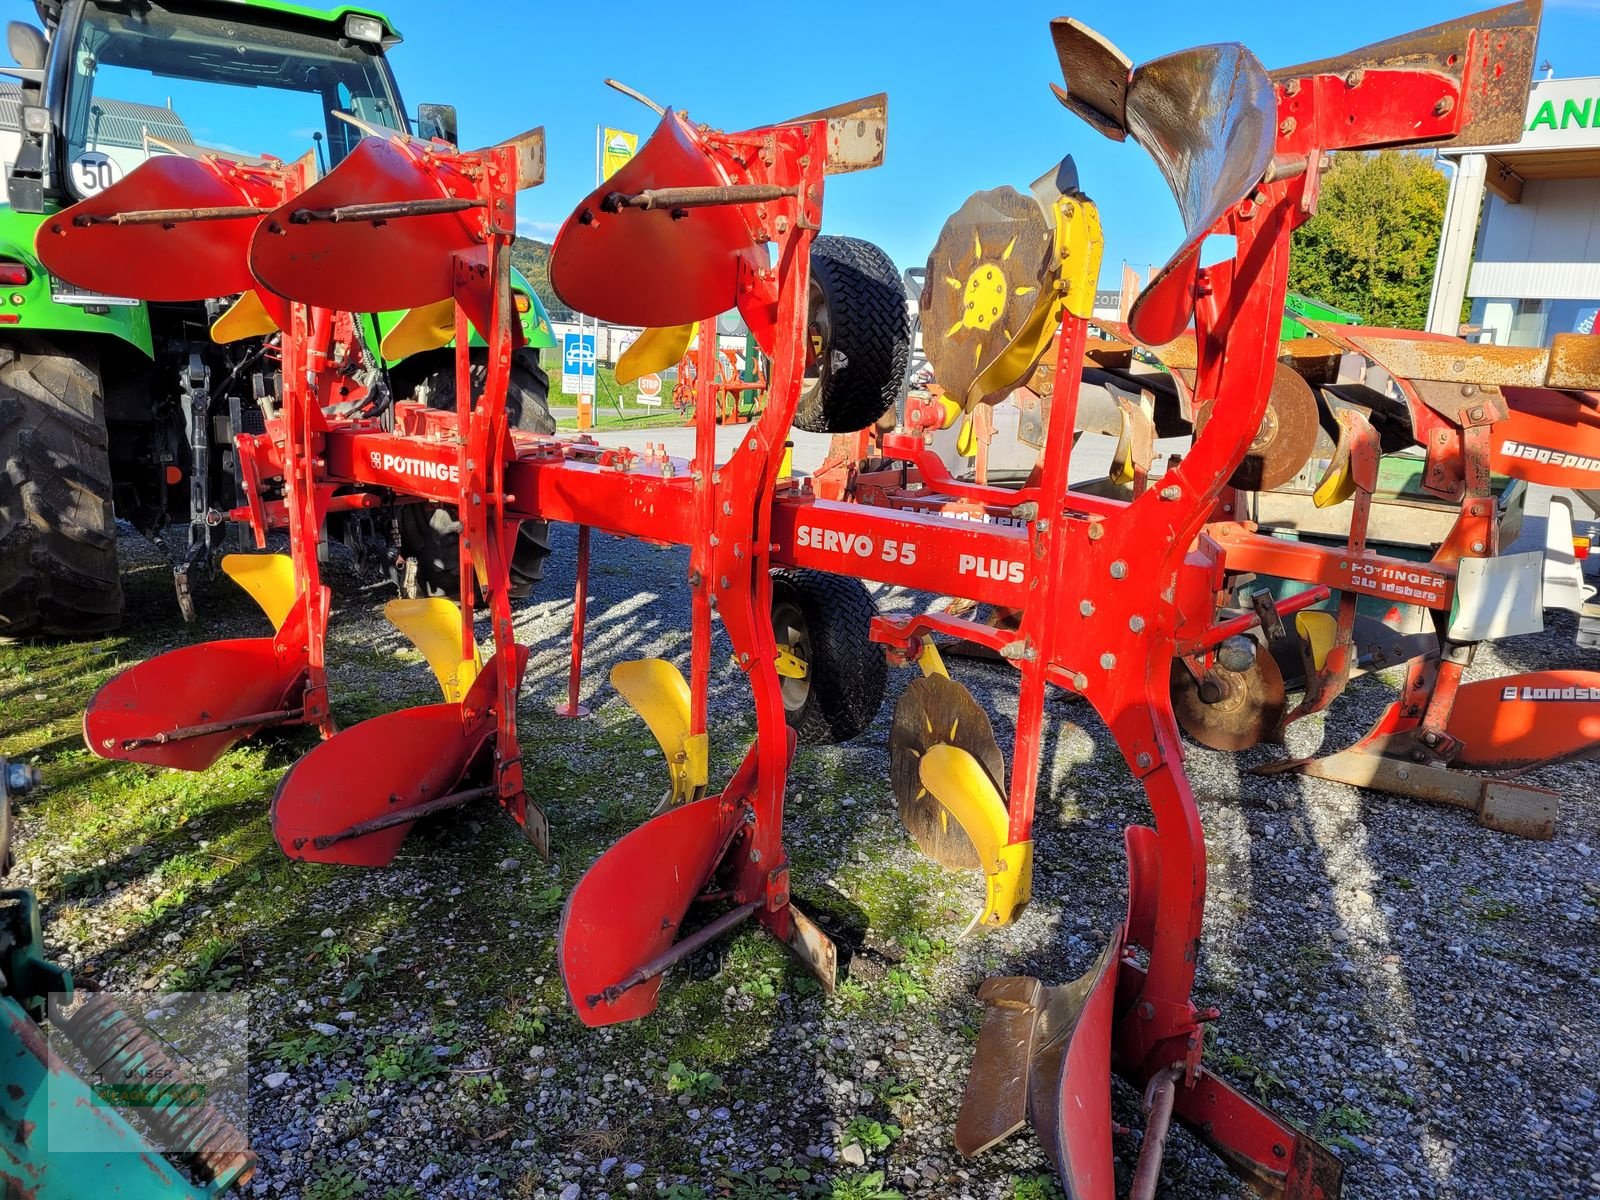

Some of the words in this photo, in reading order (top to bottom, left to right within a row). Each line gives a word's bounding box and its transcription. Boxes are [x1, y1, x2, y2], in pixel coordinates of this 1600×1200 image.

[1523, 97, 1600, 131] AN
[81, 159, 113, 190] 50
[641, 379, 659, 389] STOP
[797, 525, 873, 558] SERVO
[881, 539, 916, 565] 55
[959, 553, 1025, 584] PLUS
